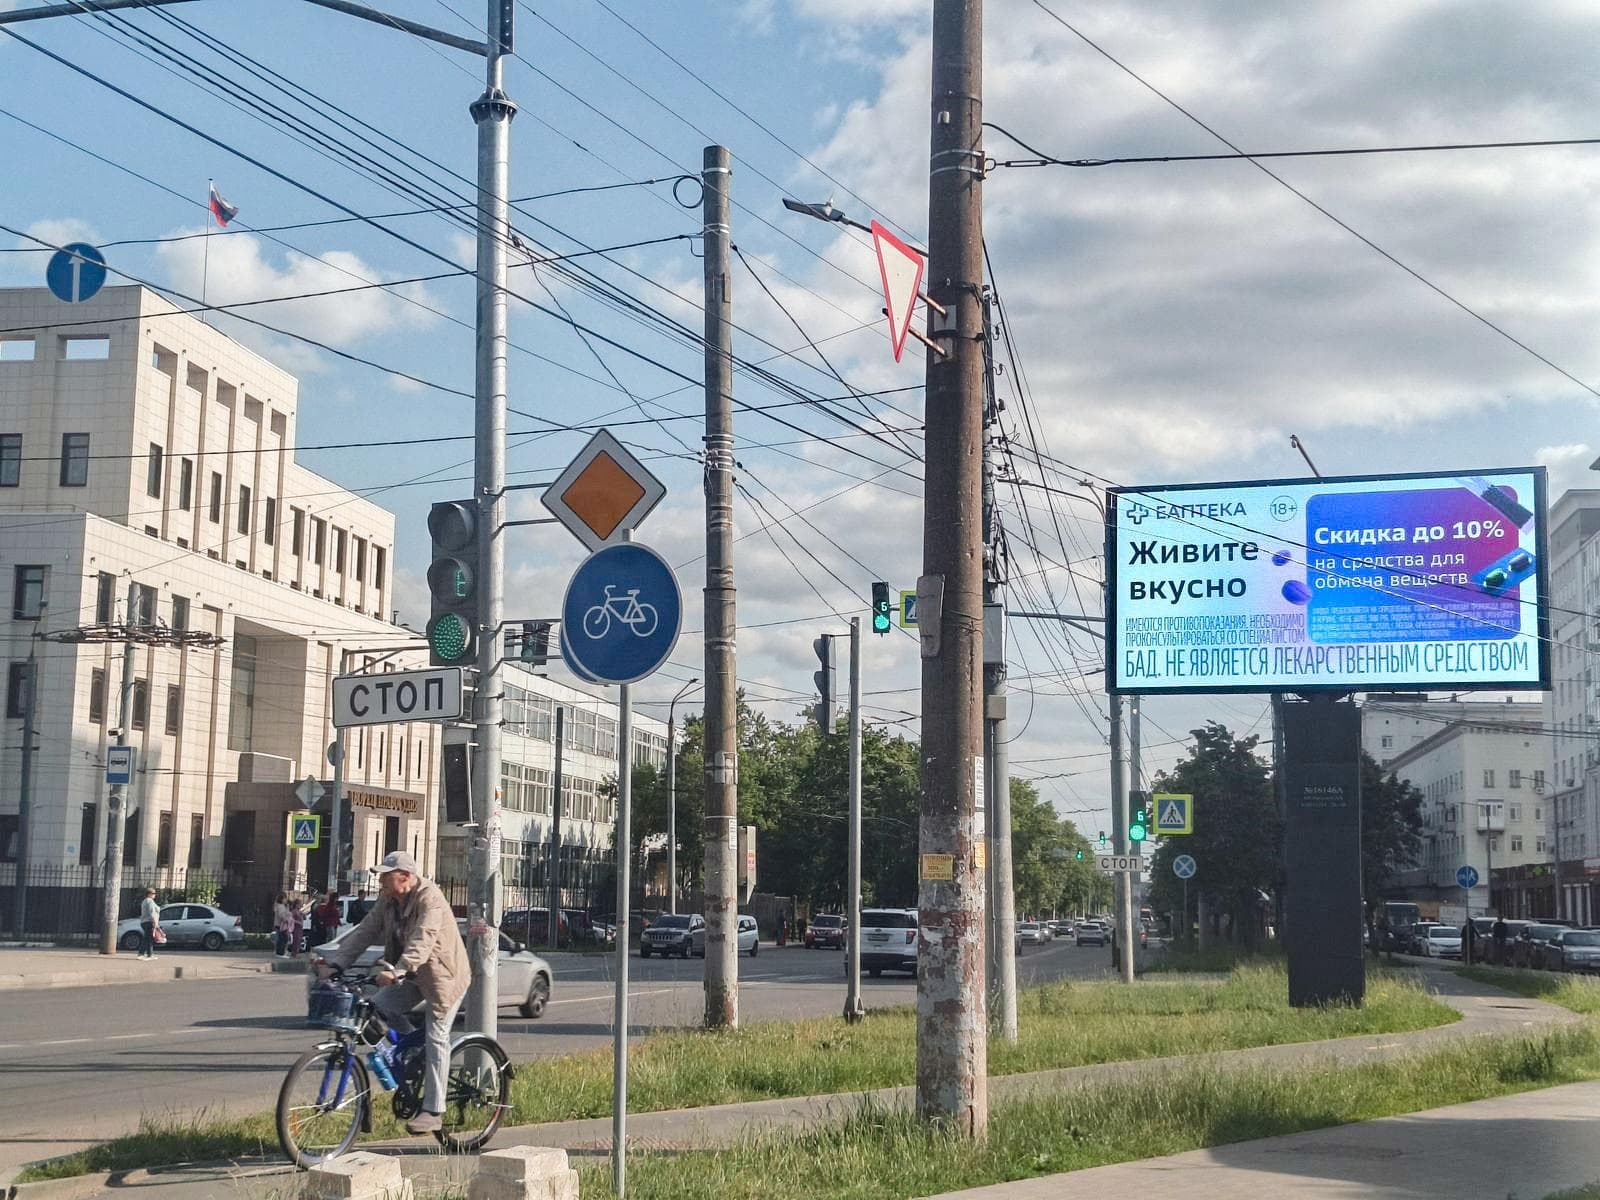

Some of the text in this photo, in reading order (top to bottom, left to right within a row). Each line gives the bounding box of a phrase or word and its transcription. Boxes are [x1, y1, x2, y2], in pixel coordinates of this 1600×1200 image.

[1157, 502, 1247, 519] ЕАПТЕКА
[1272, 503, 1297, 515] 18+
[1314, 520, 1505, 545] Скидка до 10%
[1129, 541, 1259, 565] Живите
[1315, 553, 1465, 571] на средства для
[1315, 572, 1468, 589] обмена веществ
[1130, 578, 1247, 604] вкусно
[1125, 617, 1162, 632] ИМЕЮТСЯ
[1227, 630, 1237, 645] СО
[1126, 641, 1529, 678] БАД. НЕ ЯВЛЯЕТСЯ ЛЕКАРСТВЕННЫМ СРЕДСТВОМ
[350, 677, 444, 717] СТОП
[1101, 857, 1137, 869] СТОП
